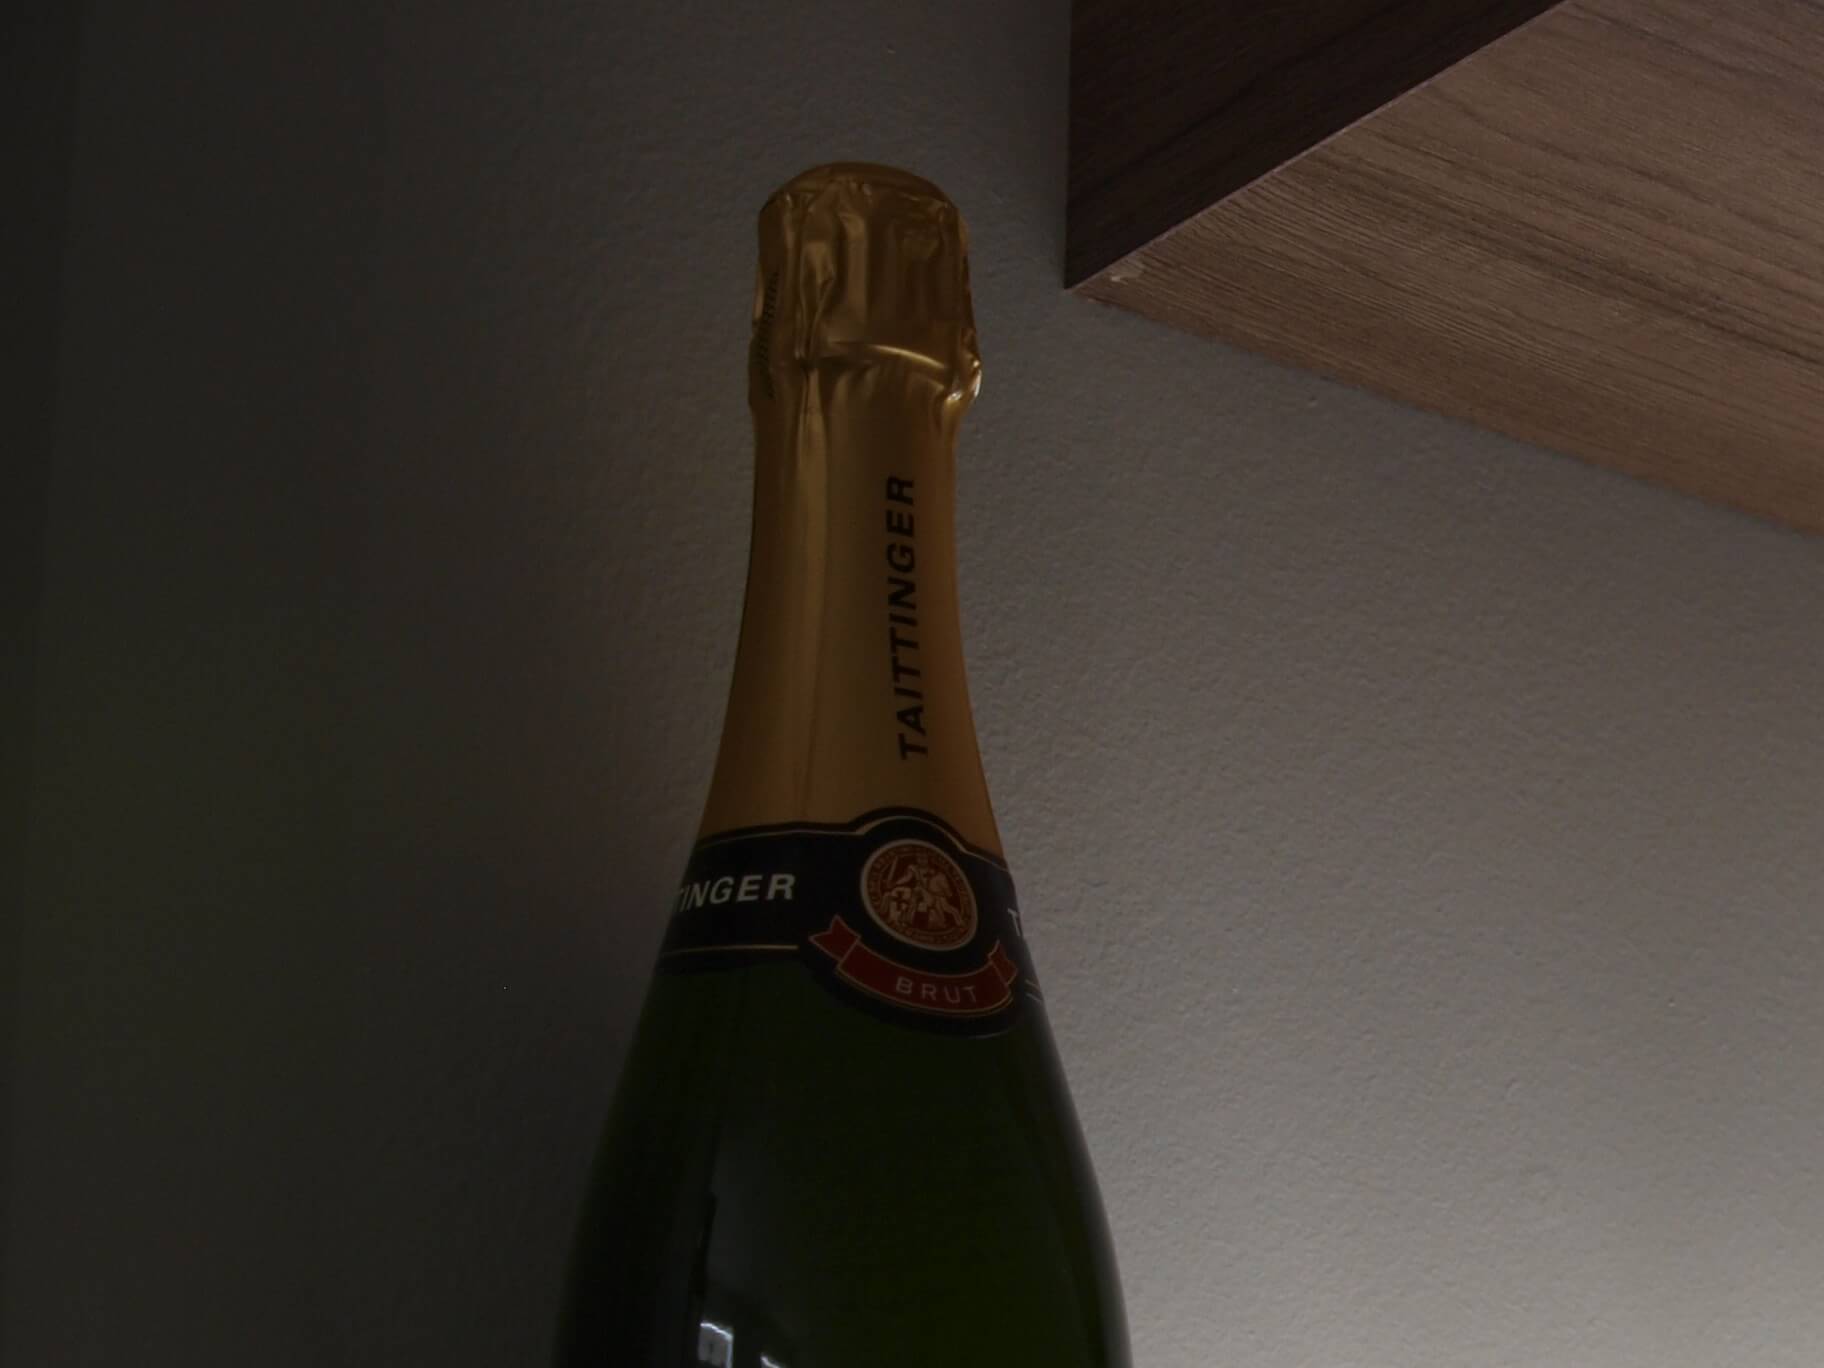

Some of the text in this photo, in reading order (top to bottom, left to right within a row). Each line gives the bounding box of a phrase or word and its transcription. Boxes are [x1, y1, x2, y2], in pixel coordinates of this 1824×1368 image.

[886, 475, 928, 761] TAITTINGER
[677, 872, 797, 914] INGER
[895, 976, 977, 1005] BRUT
